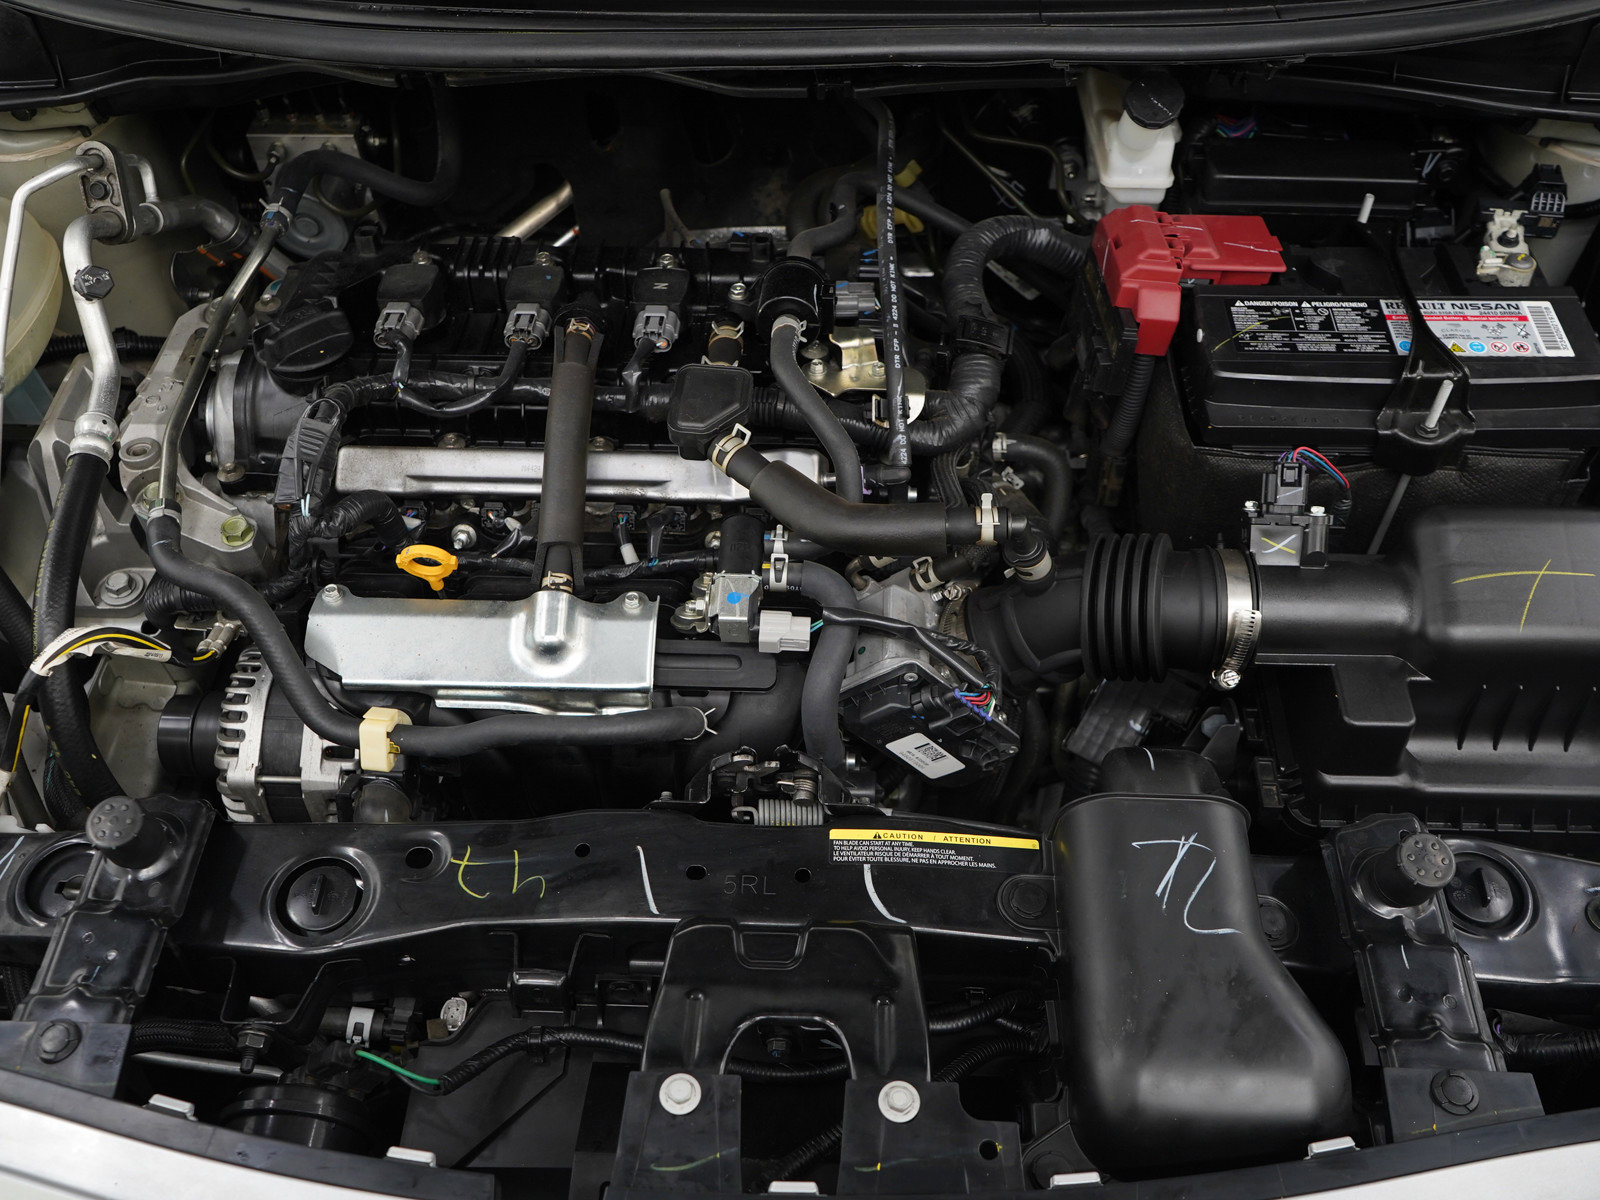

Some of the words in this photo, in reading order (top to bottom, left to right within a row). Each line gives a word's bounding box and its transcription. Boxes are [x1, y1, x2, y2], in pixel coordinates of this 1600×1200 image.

[1384, 302, 1446, 310] REULT
[1451, 303, 1520, 311] NISSAN
[882, 832, 924, 840] CAUTION
[943, 835, 992, 845] ATTENTION
[723, 875, 777, 895] 5RL
